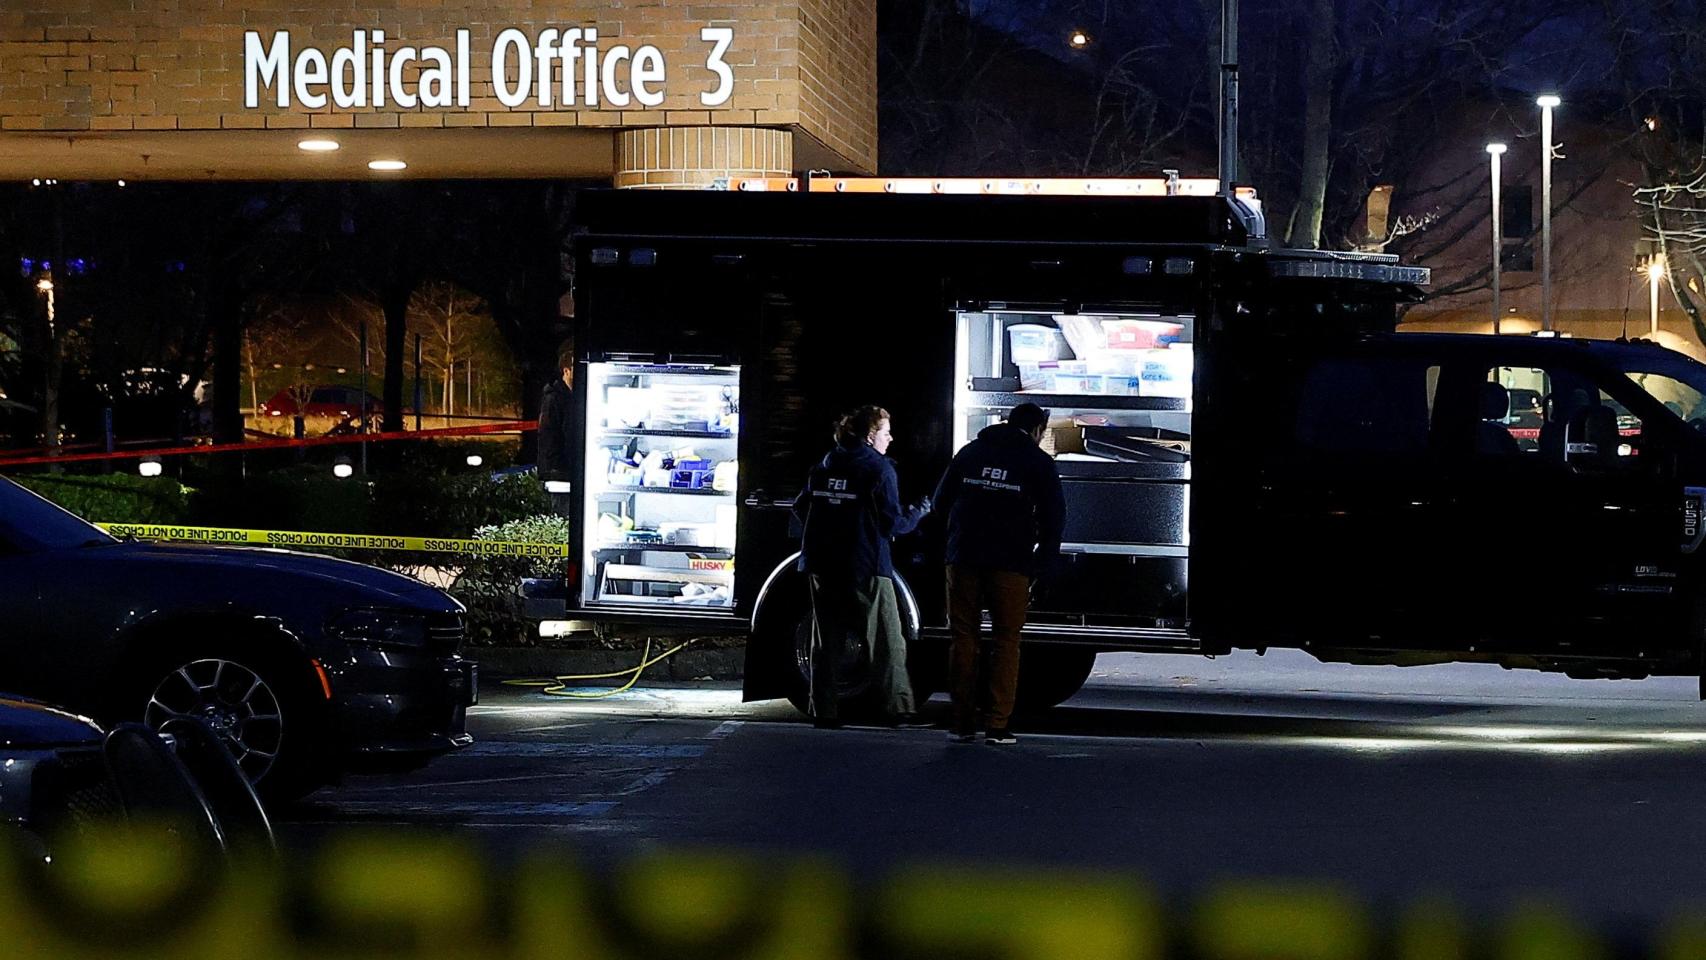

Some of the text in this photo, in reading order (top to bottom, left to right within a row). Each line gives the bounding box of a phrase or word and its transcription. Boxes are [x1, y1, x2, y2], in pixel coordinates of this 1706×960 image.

[244, 27, 735, 108] Medical Office 3
[981, 467, 1008, 481] FBI
[828, 478, 847, 490] FBI
[109, 524, 248, 541] POLICE LINE DO NOT CROSS
[267, 532, 405, 549] POLICE LINE DO NOT CROSS
[424, 540, 562, 556] POLICE LINE DO NOT CROSS
[692, 561, 726, 570] HUSKY
